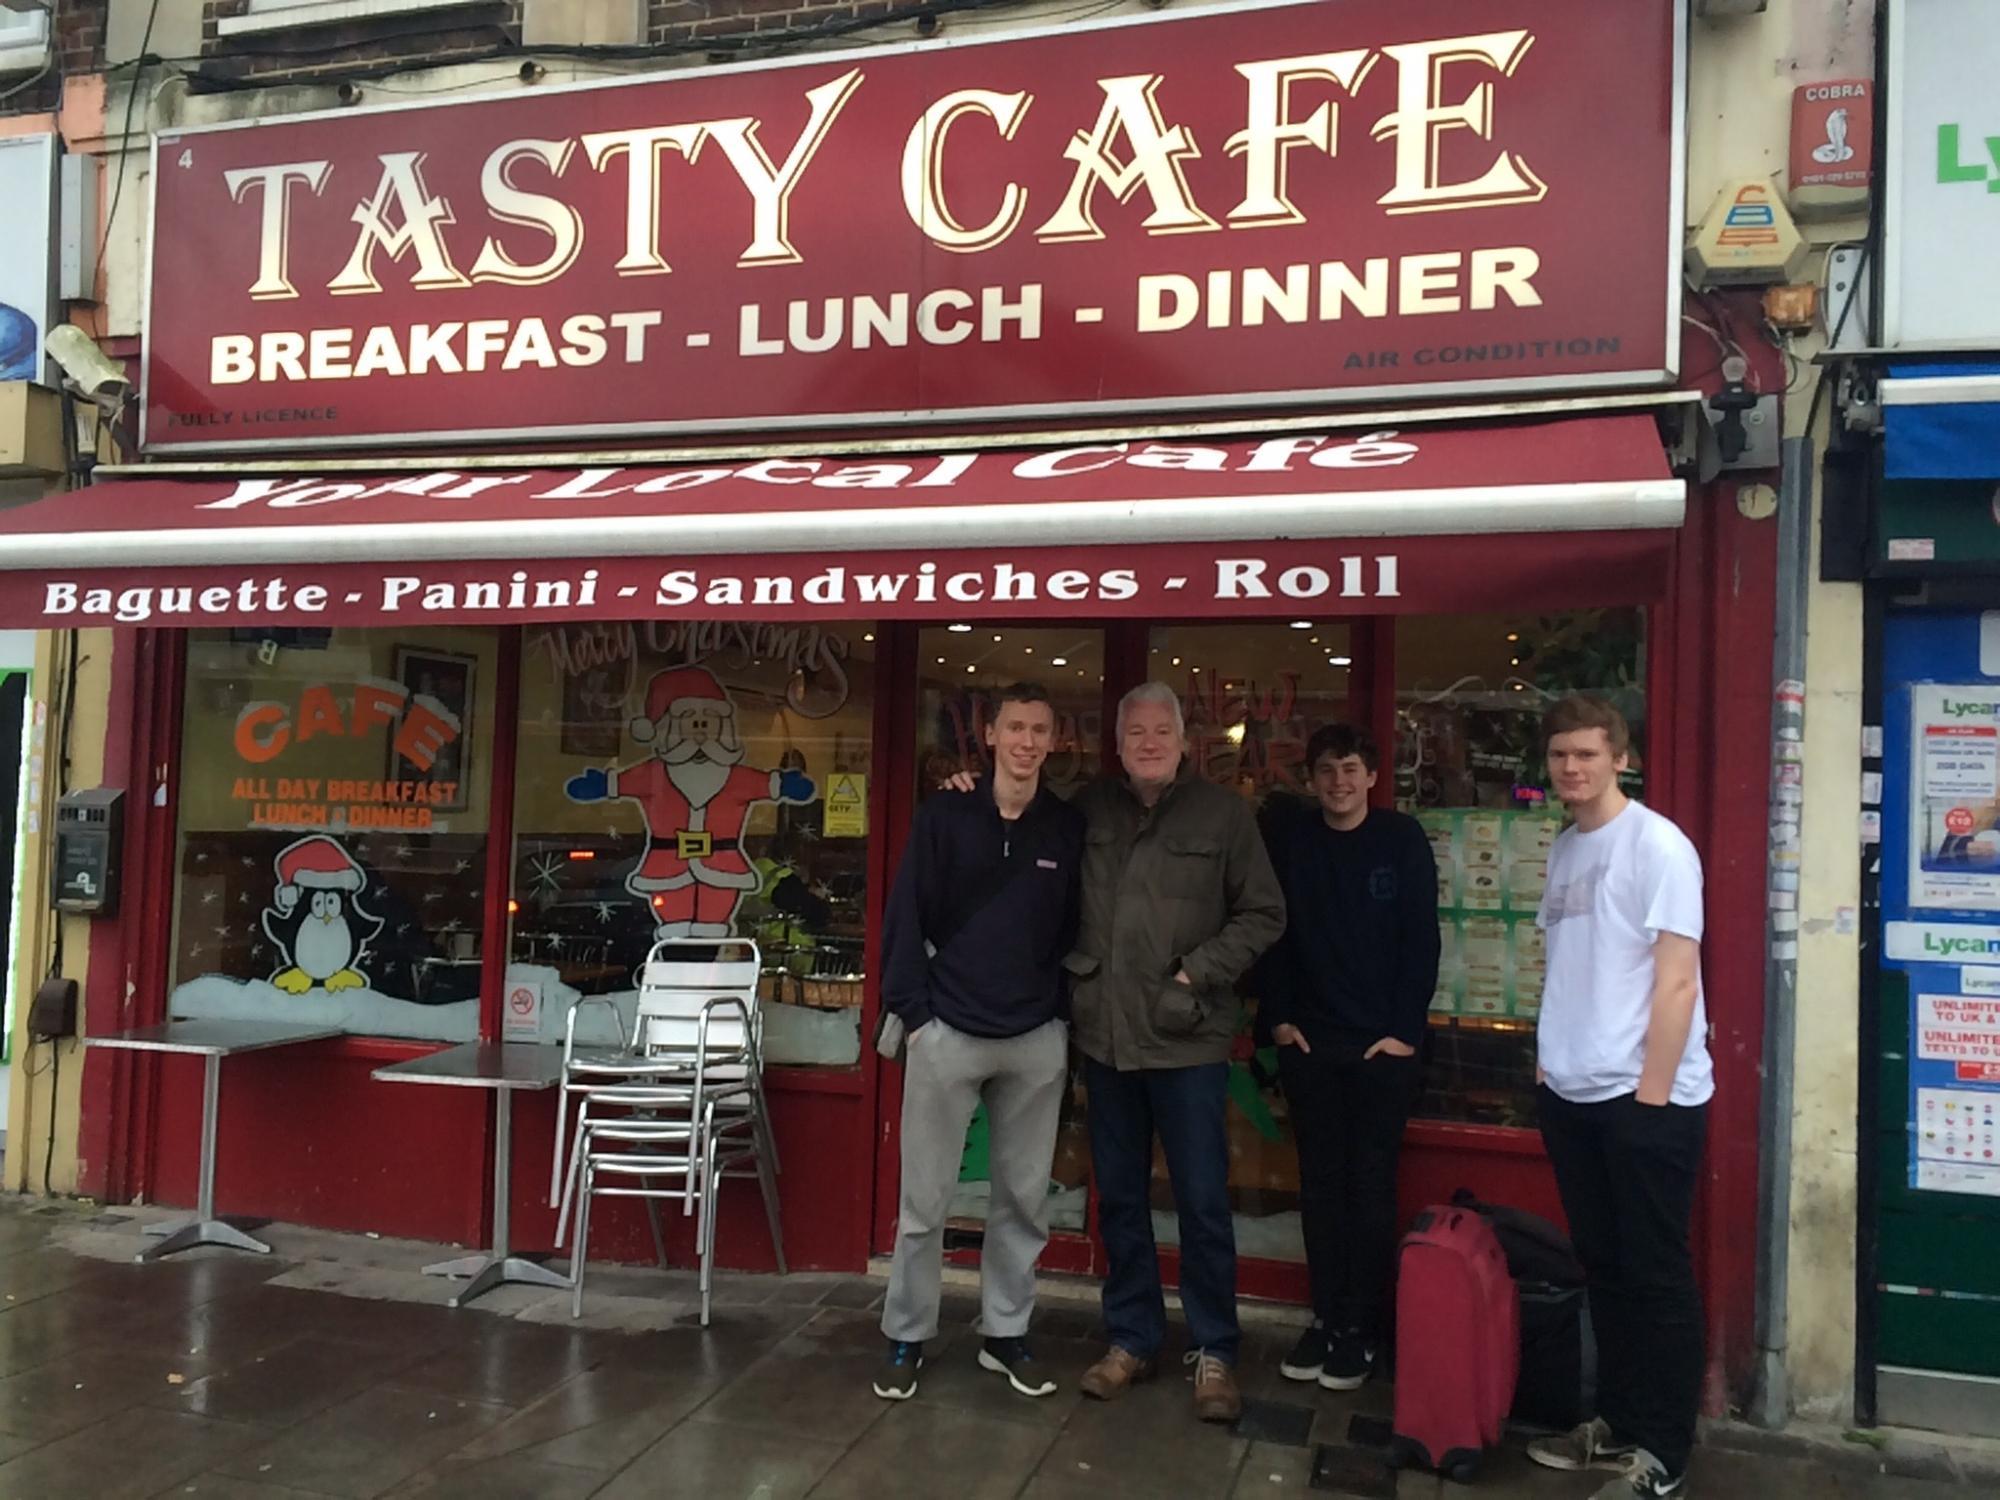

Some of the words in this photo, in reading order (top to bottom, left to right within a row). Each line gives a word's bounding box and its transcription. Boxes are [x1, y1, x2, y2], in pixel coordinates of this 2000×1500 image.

[1805, 84, 1865, 101] COBRA
[178, 150, 194, 170] 4
[225, 68, 865, 301] TASTY
[902, 30, 1548, 253] CAFE
[211, 311, 662, 386] BREAKFAST
[740, 284, 1043, 357] LUNCH
[1138, 247, 1544, 334] DINNER
[1344, 352, 1400, 369] AIR
[1413, 338, 1620, 366] CONDITION
[168, 412, 233, 427] FULLY
[242, 407, 338, 424] LICENCE
[531, 454, 979, 498] Local
[1012, 430, 1420, 478] Café
[43, 580, 330, 623] Baguette
[381, 570, 600, 612] Panini
[657, 563, 1140, 607] Sandwiches
[1216, 556, 1401, 599] Roll
[234, 680, 462, 772] CAFE
[232, 778, 270, 799] ALL
[276, 779, 321, 799] DAY
[327, 781, 458, 803] BREAKFAST
[254, 804, 327, 824] LUNCH
[350, 808, 432, 828] DINNER
[1937, 1012, 1955, 1021] TO
[1961, 1013, 1980, 1023] UK
[1986, 1014, 1996, 1024] &
[1970, 1046, 1989, 1055] TO
